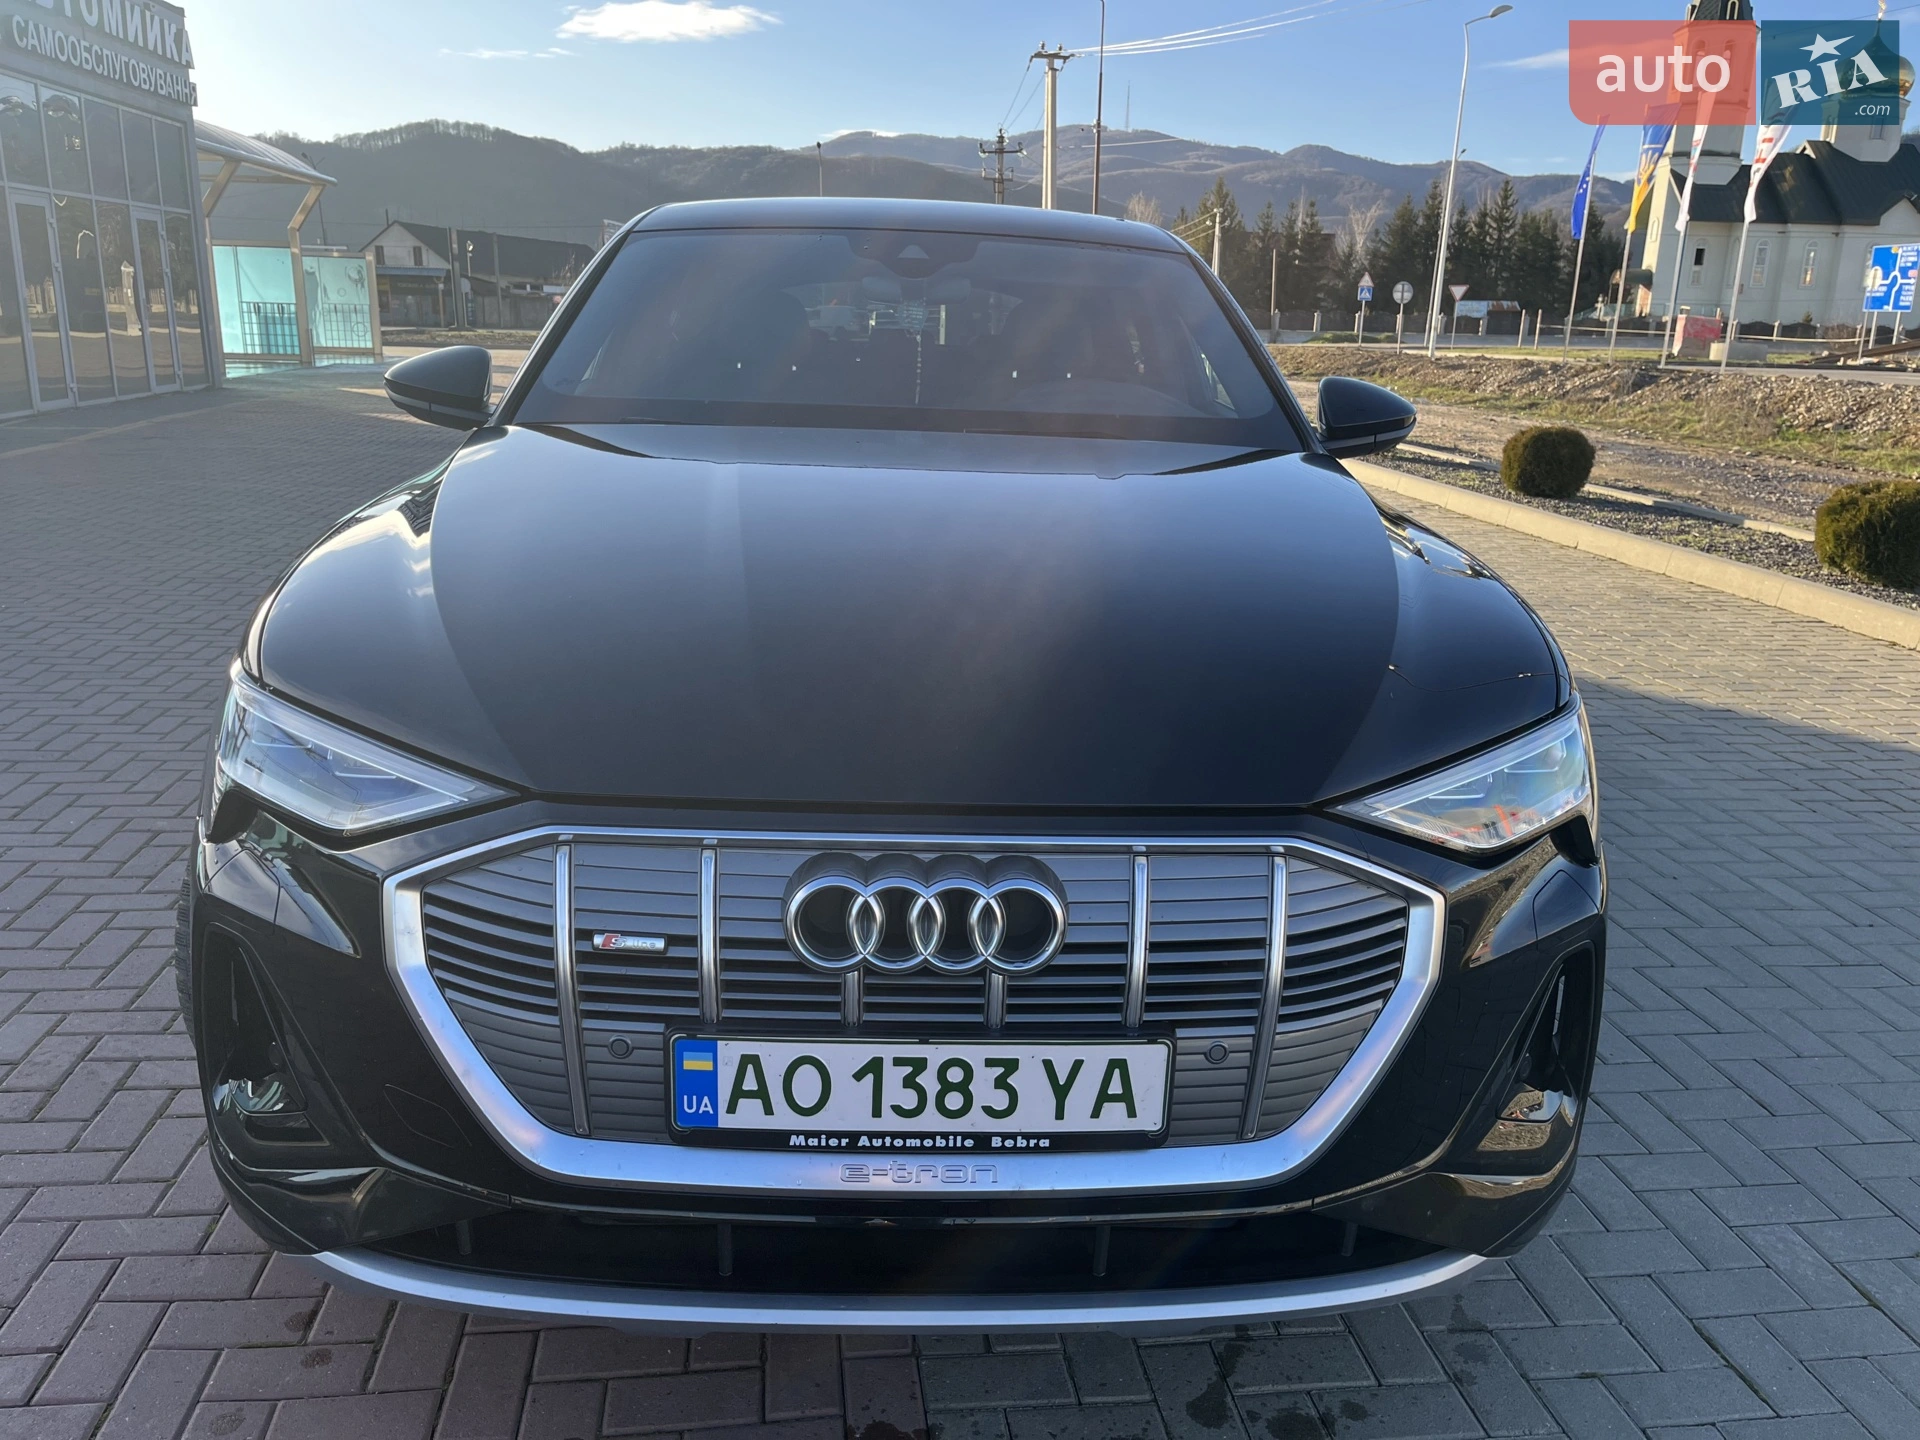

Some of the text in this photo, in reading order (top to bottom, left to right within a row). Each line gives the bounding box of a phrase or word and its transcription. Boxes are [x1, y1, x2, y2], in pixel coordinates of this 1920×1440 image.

[12, 14, 198, 106] САМООБСЛУГОВУВАННЯ
[725, 1054, 1138, 1120] AO 1383 YA
[683, 1095, 714, 1115] UA
[789, 1134, 1050, 1148] Maier Automobile Bebra
[839, 1160, 998, 1184] e-tron
